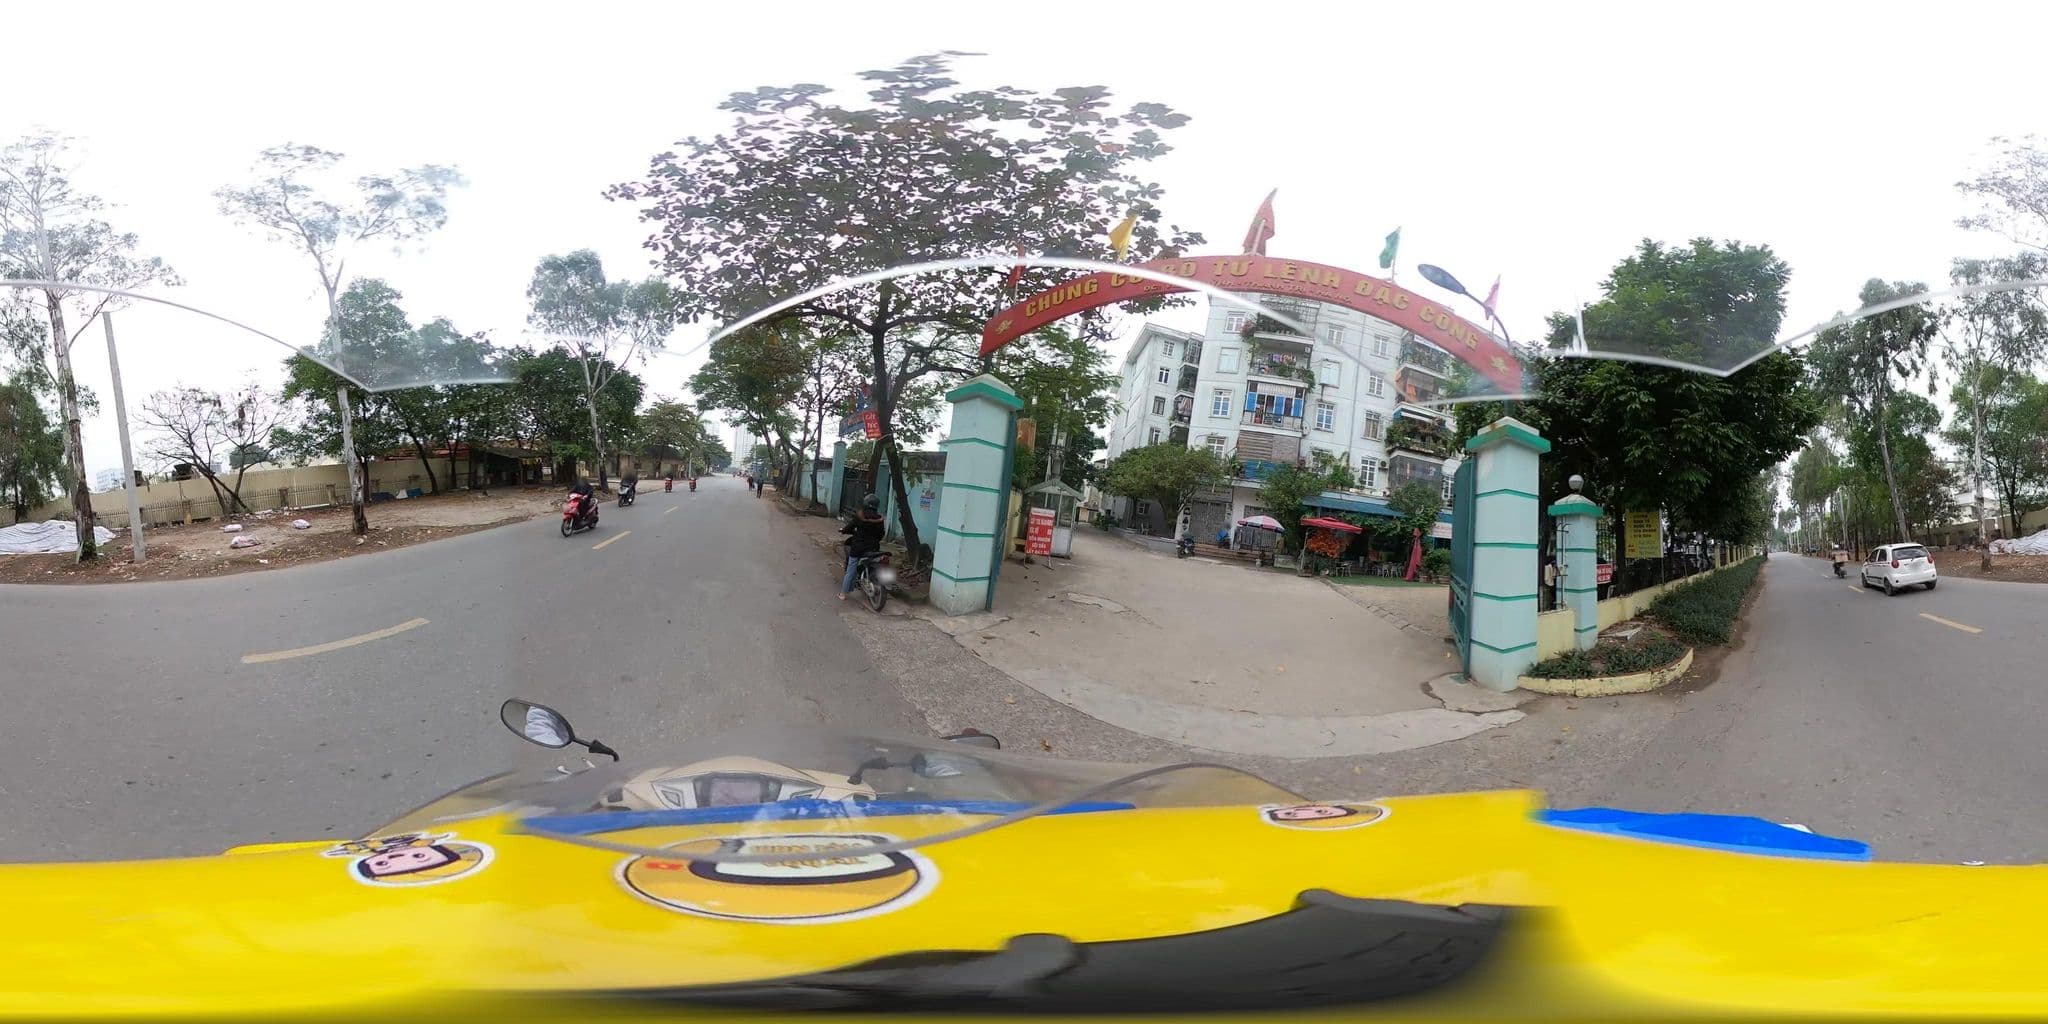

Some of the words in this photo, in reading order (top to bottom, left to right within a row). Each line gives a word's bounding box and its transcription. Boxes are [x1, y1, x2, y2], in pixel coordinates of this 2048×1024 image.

[1025, 278, 1099, 317] CHUNG
[1213, 259, 1253, 276] TƯ
[1263, 261, 1341, 289] LỆNH
[1353, 279, 1409, 310] ĐẶC
[1418, 304, 1478, 351] CÔNG
